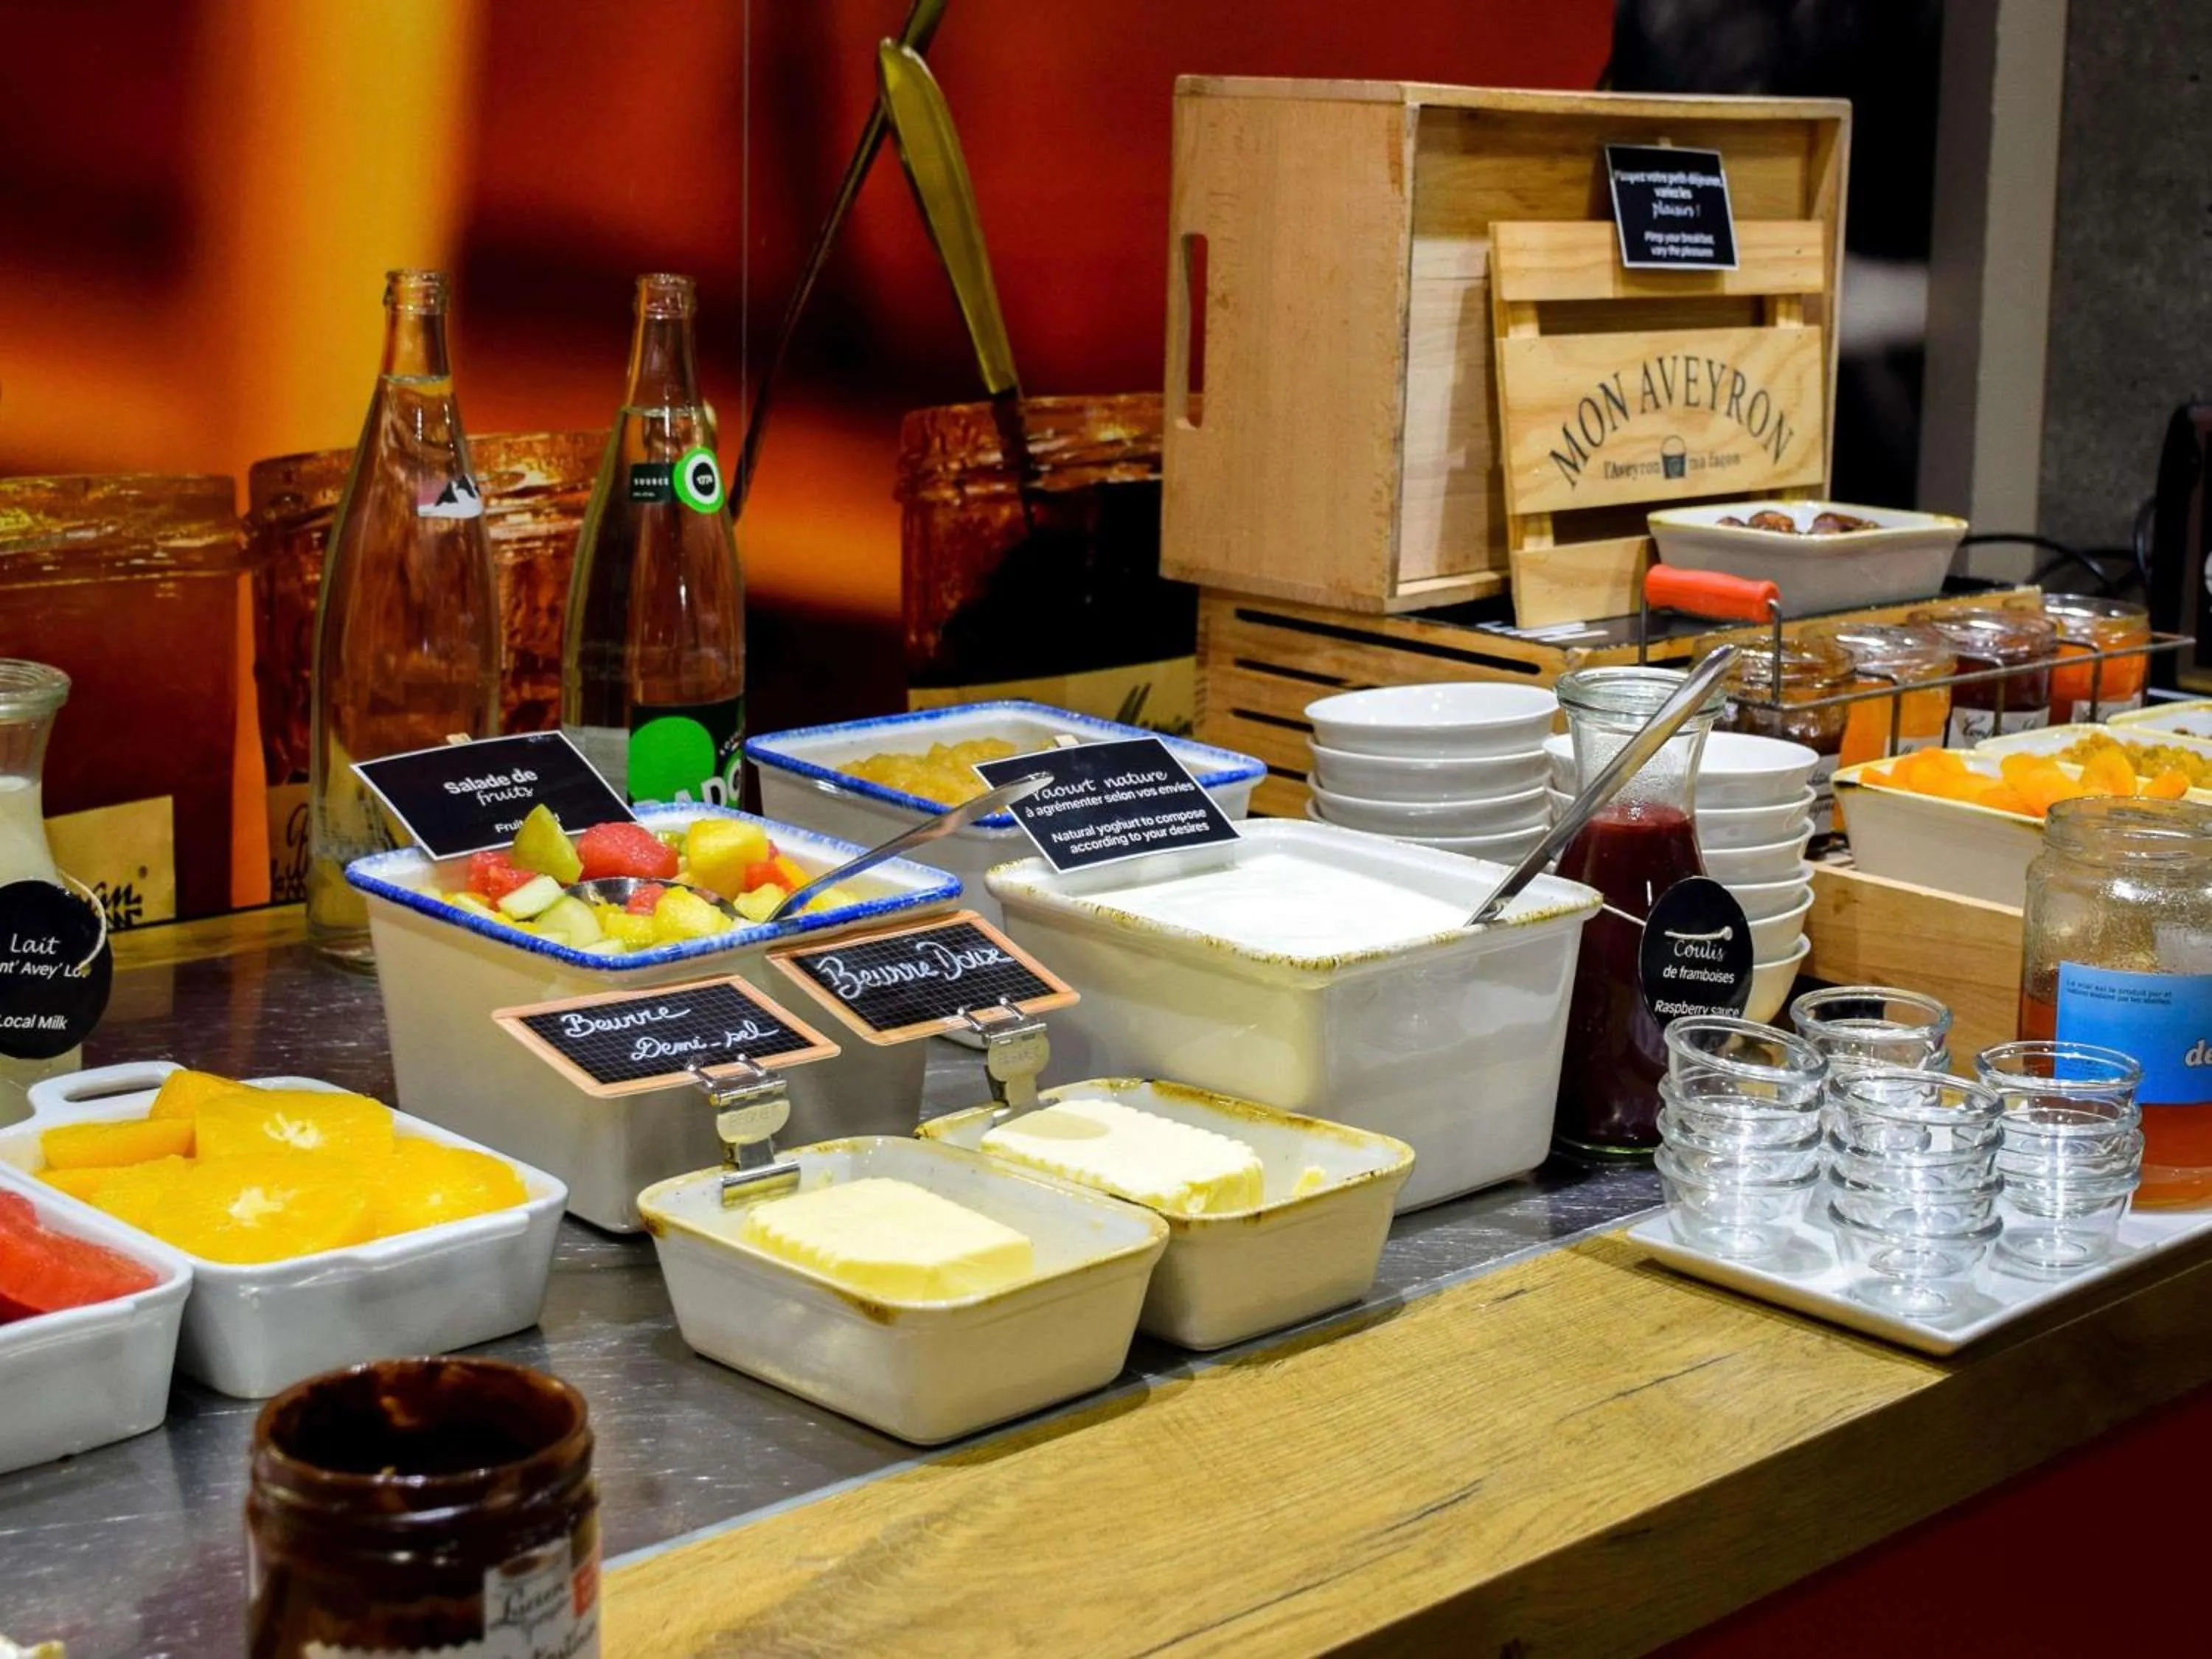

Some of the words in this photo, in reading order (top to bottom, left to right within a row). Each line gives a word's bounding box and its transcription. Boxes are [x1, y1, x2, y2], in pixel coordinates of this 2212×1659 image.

[1549, 371, 1630, 490] MON
[1641, 355, 1794, 467] AVEYRON
[443, 773, 511, 796] Salade
[512, 768, 538, 784] de
[1103, 771, 1168, 789] nature
[477, 784, 534, 807] fruits
[1024, 806, 1035, 818] à
[1036, 796, 1103, 818] agrémenter
[1105, 791, 1135, 804] selon
[1136, 787, 1158, 798] vos
[1158, 782, 1195, 795] envies
[1051, 824, 1096, 844] Natural
[1096, 818, 1140, 836] yoghurt
[1141, 815, 1155, 827] to
[1155, 808, 1207, 824] compose
[1070, 833, 1129, 854] according
[1128, 832, 1142, 842] to
[1142, 827, 1168, 842] your
[1169, 821, 1210, 836] desires
[10, 932, 61, 956] Lait
[1673, 939, 1728, 962] Coulis
[64, 965, 87, 978] Lo
[816, 956, 939, 1000] Beurre
[1663, 964, 1677, 979] de
[1679, 965, 1735, 984] framboises
[1655, 998, 1708, 1018] Raspberry
[1710, 1004, 1740, 1017] sauce
[38, 1015, 69, 1031] Milk
[560, 1005, 691, 1037] Beurre
